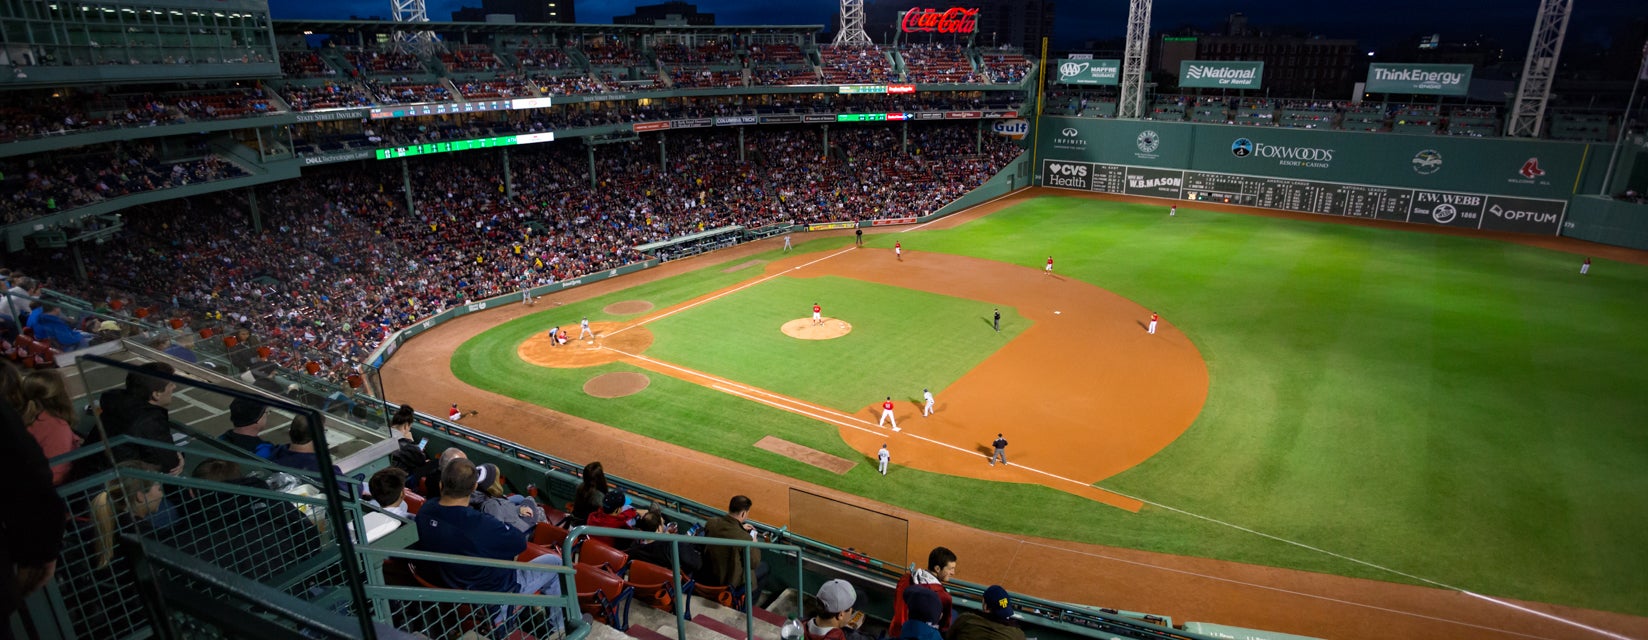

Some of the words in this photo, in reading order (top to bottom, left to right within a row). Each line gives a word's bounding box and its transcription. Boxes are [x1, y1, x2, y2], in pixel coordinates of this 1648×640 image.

[902, 7, 979, 33] Coca-Cola
[1202, 66, 1256, 78] National
[1375, 68, 1462, 84] ThinkEnergy
[994, 122, 1027, 133] Gulf
[323, 154, 356, 163] Technologies
[1255, 143, 1333, 162] FOXWOODS
[1062, 164, 1087, 176] CVS
[1050, 174, 1086, 187] Health
[1442, 194, 1481, 206] WEBB
[1504, 210, 1557, 223] OPTUM
